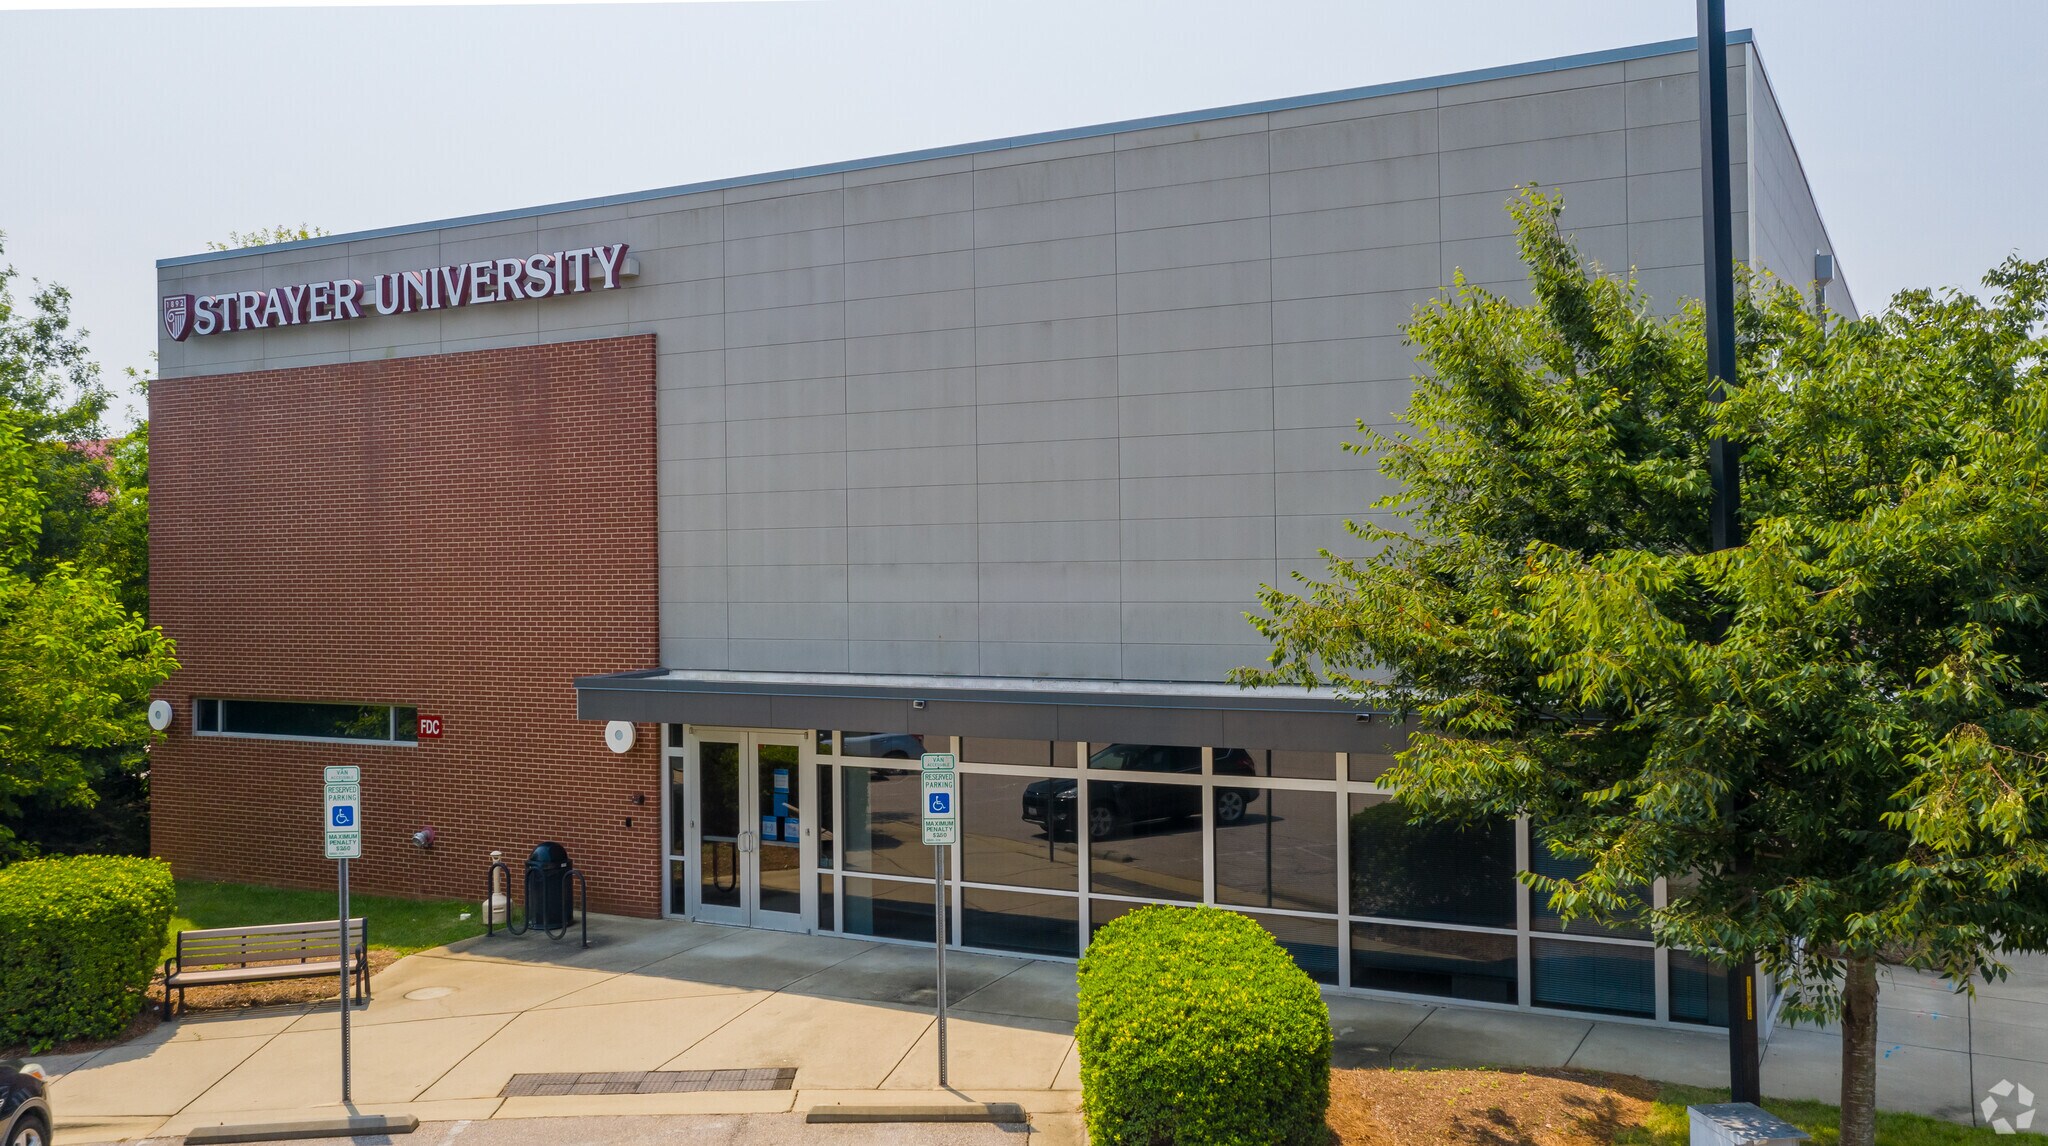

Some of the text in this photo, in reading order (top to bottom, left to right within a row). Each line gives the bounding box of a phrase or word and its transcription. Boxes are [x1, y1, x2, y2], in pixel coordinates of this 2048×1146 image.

[194, 244, 629, 335] STRAYER UNIVERSITY
[166, 300, 184, 308] 1892
[420, 719, 440, 735] FDC
